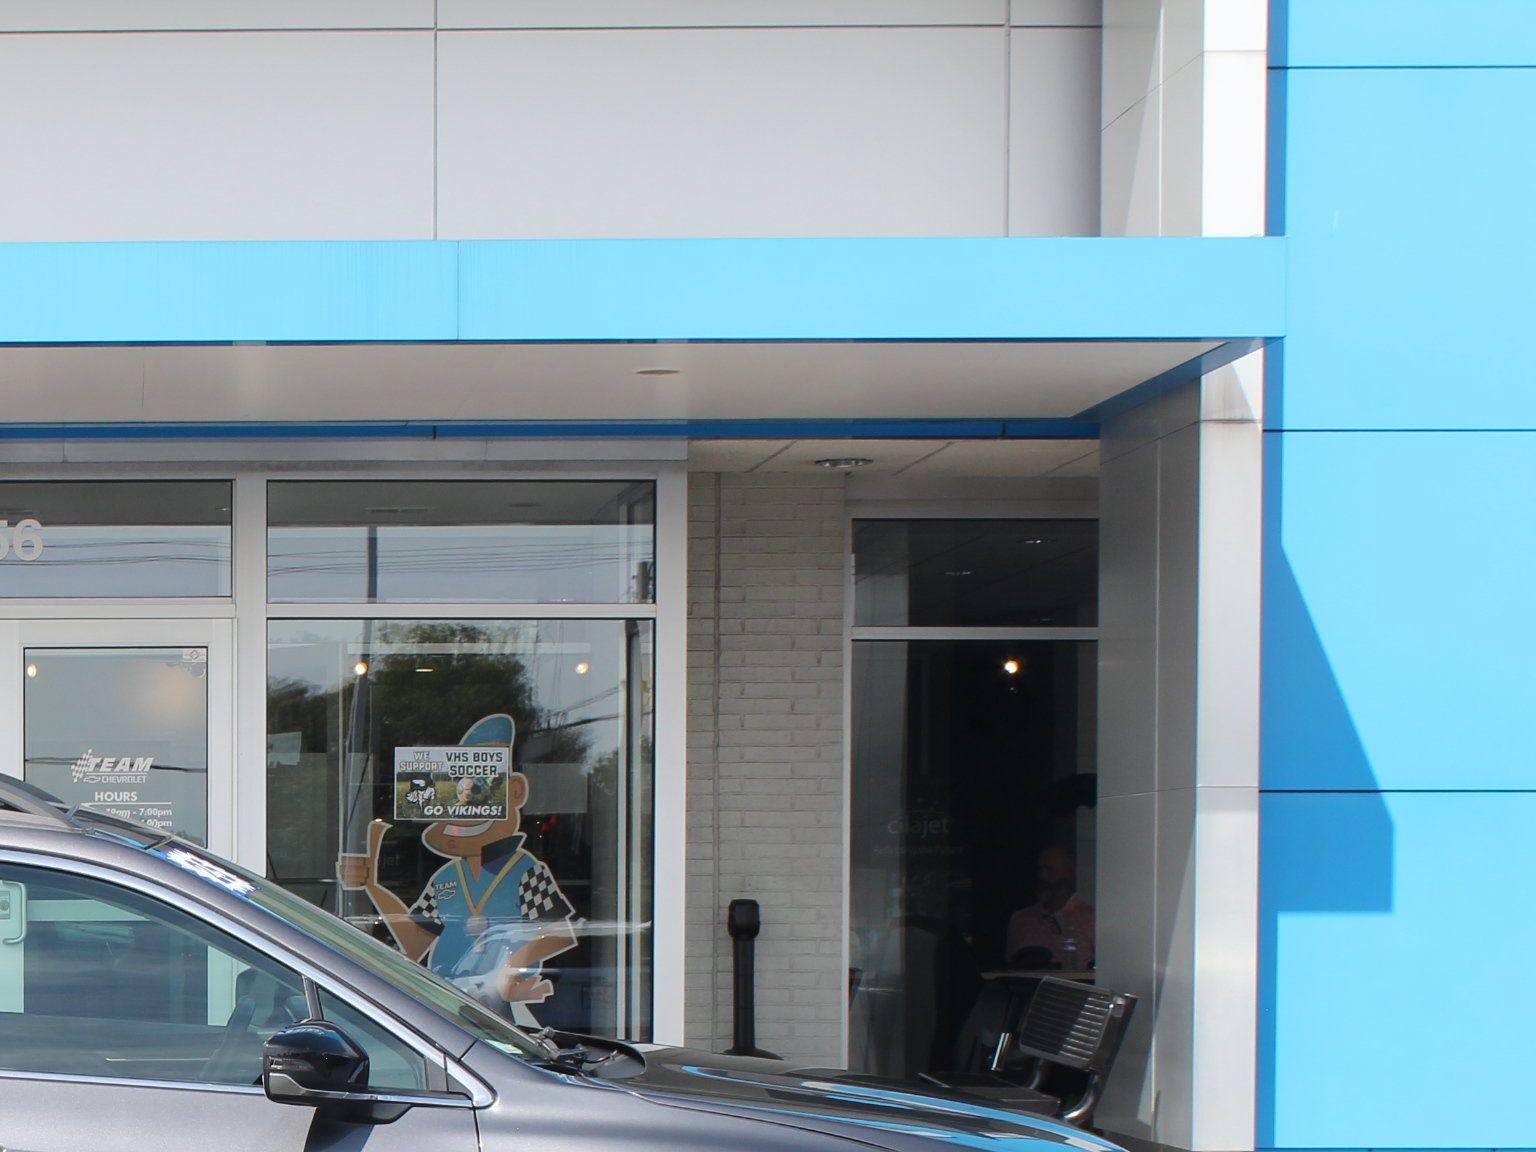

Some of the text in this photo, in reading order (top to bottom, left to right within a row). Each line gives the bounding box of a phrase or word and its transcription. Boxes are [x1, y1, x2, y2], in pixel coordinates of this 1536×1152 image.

[413, 751, 430, 761] WE
[445, 752, 503, 762] VHS BOYS
[88, 757, 154, 772] TEAM
[400, 761, 443, 771] SUPPORT
[449, 765, 497, 776] SOCCER
[101, 775, 148, 784] CHEVROLET
[94, 791, 138, 802] HOURS
[139, 808, 173, 817] 7:00pm
[424, 805, 502, 816] GO VIKINGS!
[435, 881, 457, 890] TEAM
